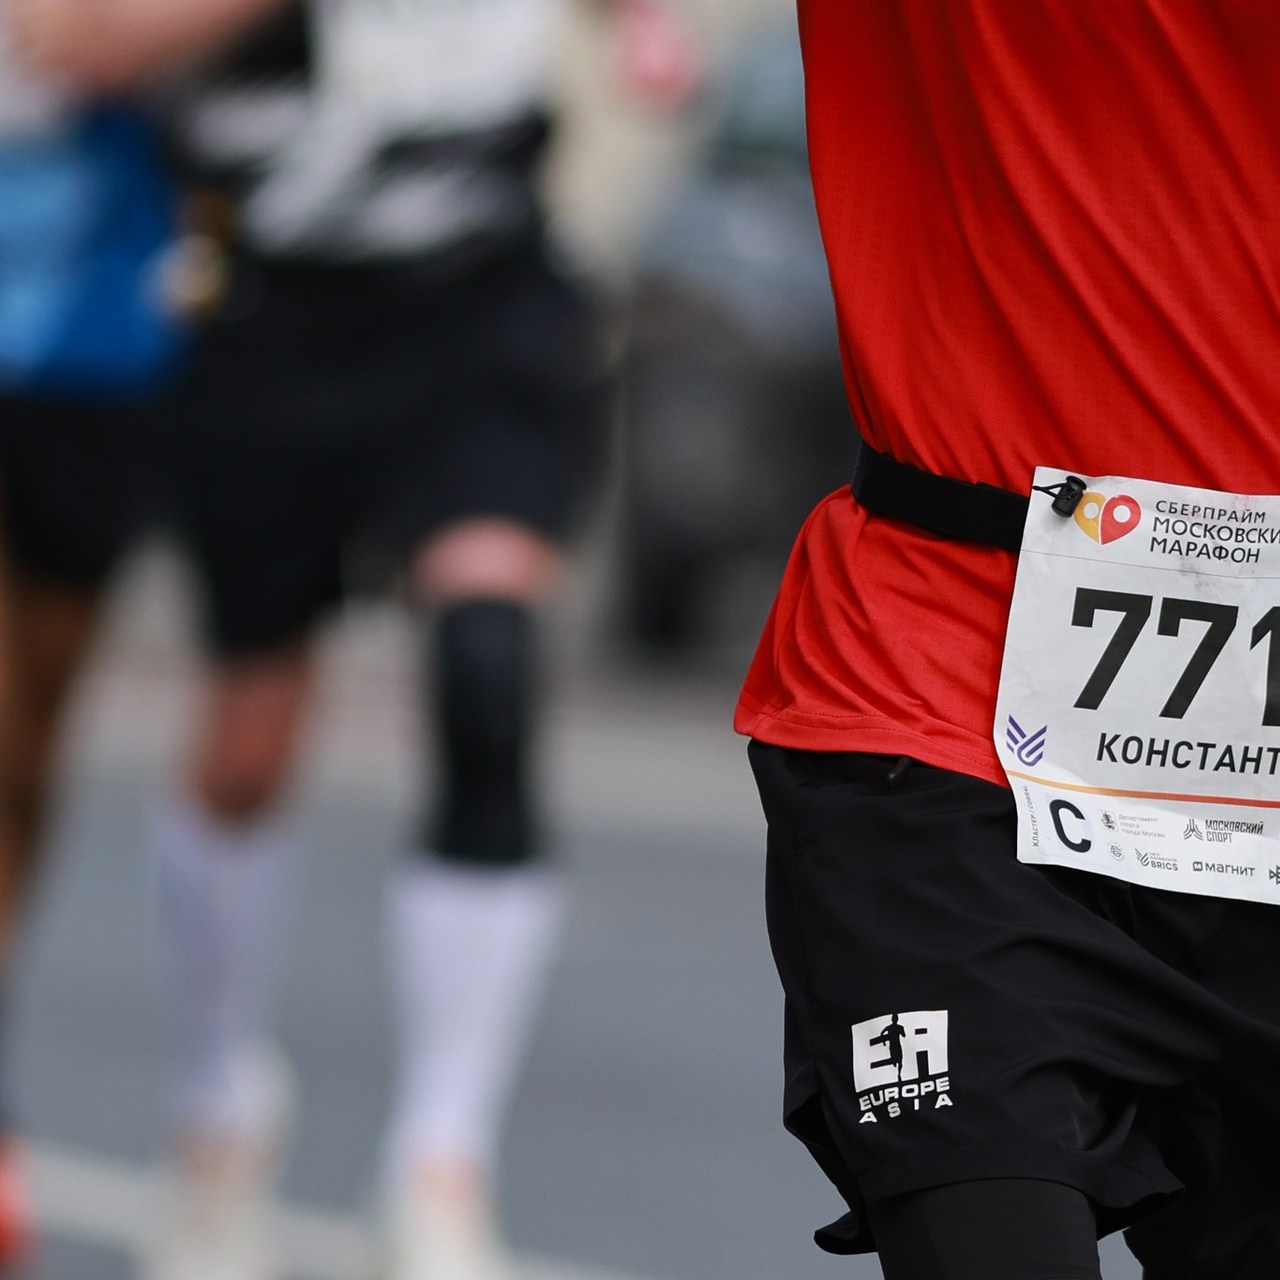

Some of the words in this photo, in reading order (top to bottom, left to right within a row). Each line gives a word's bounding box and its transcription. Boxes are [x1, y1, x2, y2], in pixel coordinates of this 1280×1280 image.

[1155, 500, 1266, 524] СБЕРПРАЙМ
[1150, 536, 1261, 564] МАРАФОН
[1205, 819, 1264, 835] МОСКОВСКИЙ
[1206, 830, 1233, 843] СПОРТ
[1150, 860, 1179, 872] BRICS
[858, 1076, 951, 1111] EUROPE
[858, 1093, 954, 1124] ASIA
